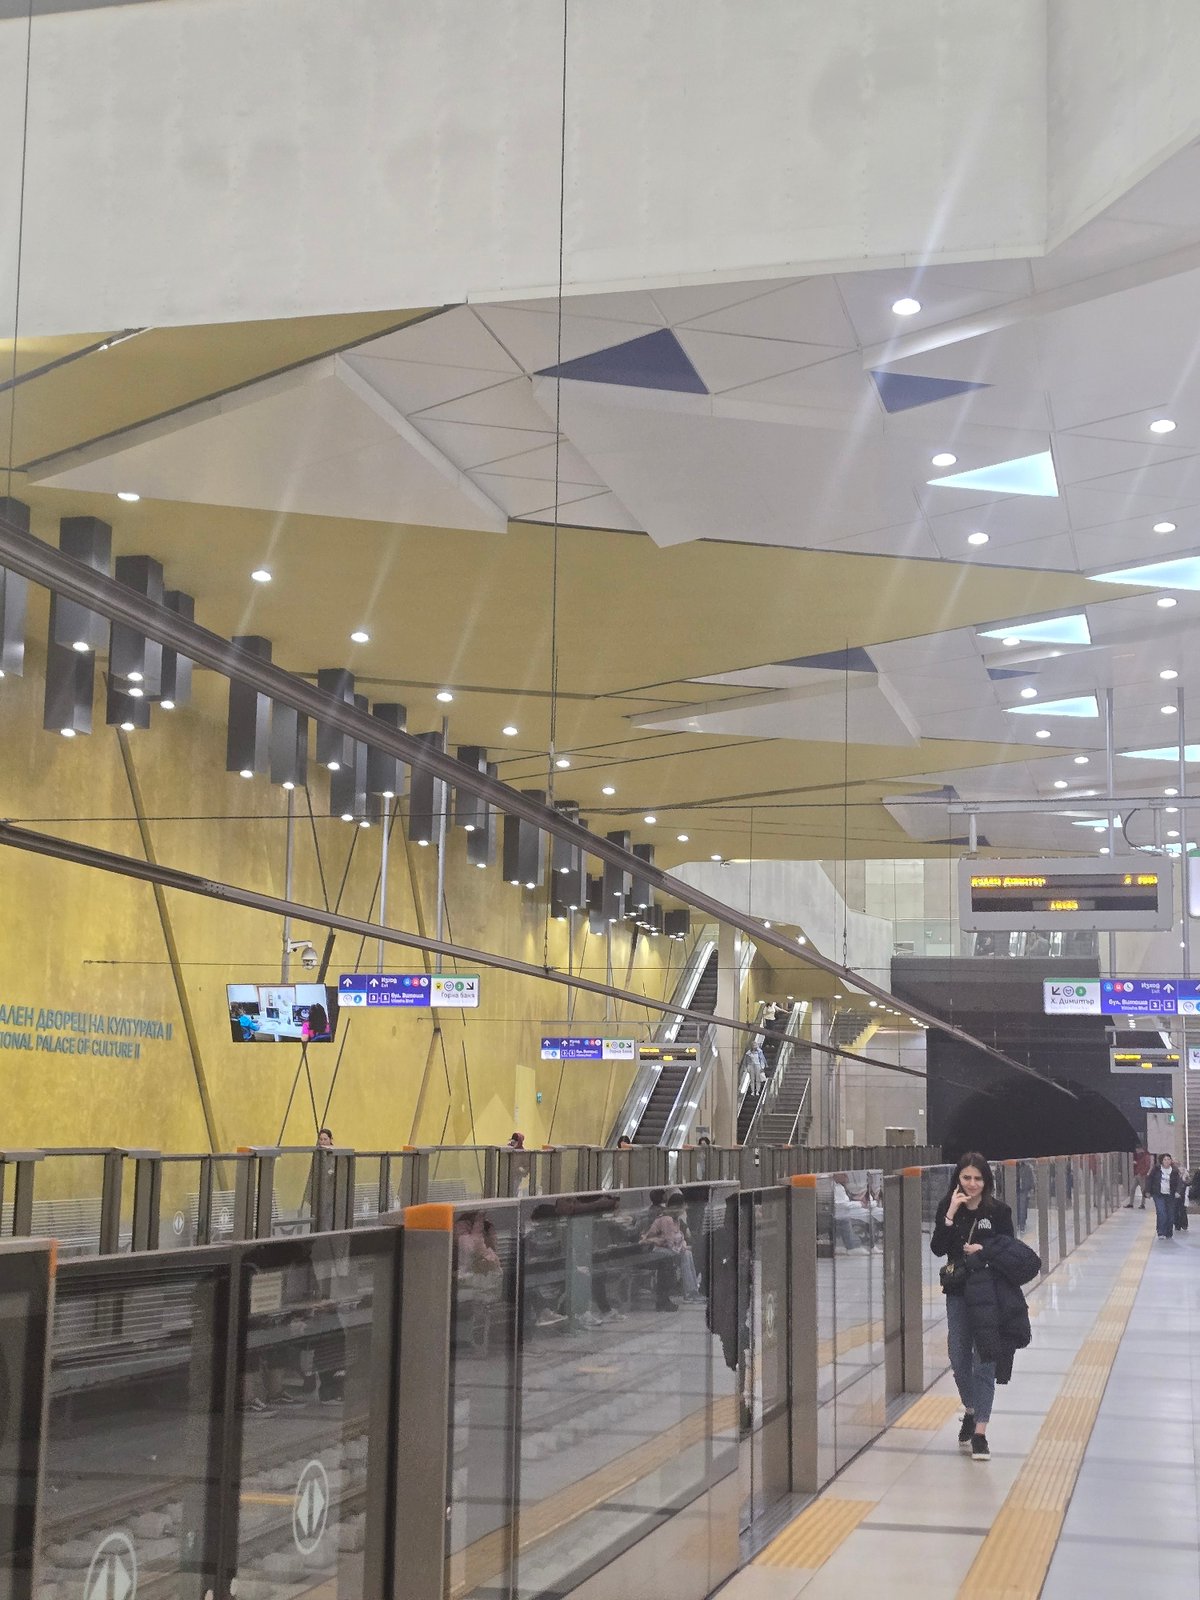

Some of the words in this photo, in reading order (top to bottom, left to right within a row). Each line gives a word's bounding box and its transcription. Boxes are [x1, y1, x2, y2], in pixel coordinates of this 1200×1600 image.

[1059, 998, 1095, 1006] Димитър
[36, 1008, 86, 1035] ДВОРЕЦ
[88, 1013, 104, 1034] НА
[107, 1016, 164, 1040] КУЛТУРАТА
[36, 1034, 75, 1054] PALACE
[77, 1038, 90, 1055] OF
[92, 1039, 133, 1058] CULTURE
